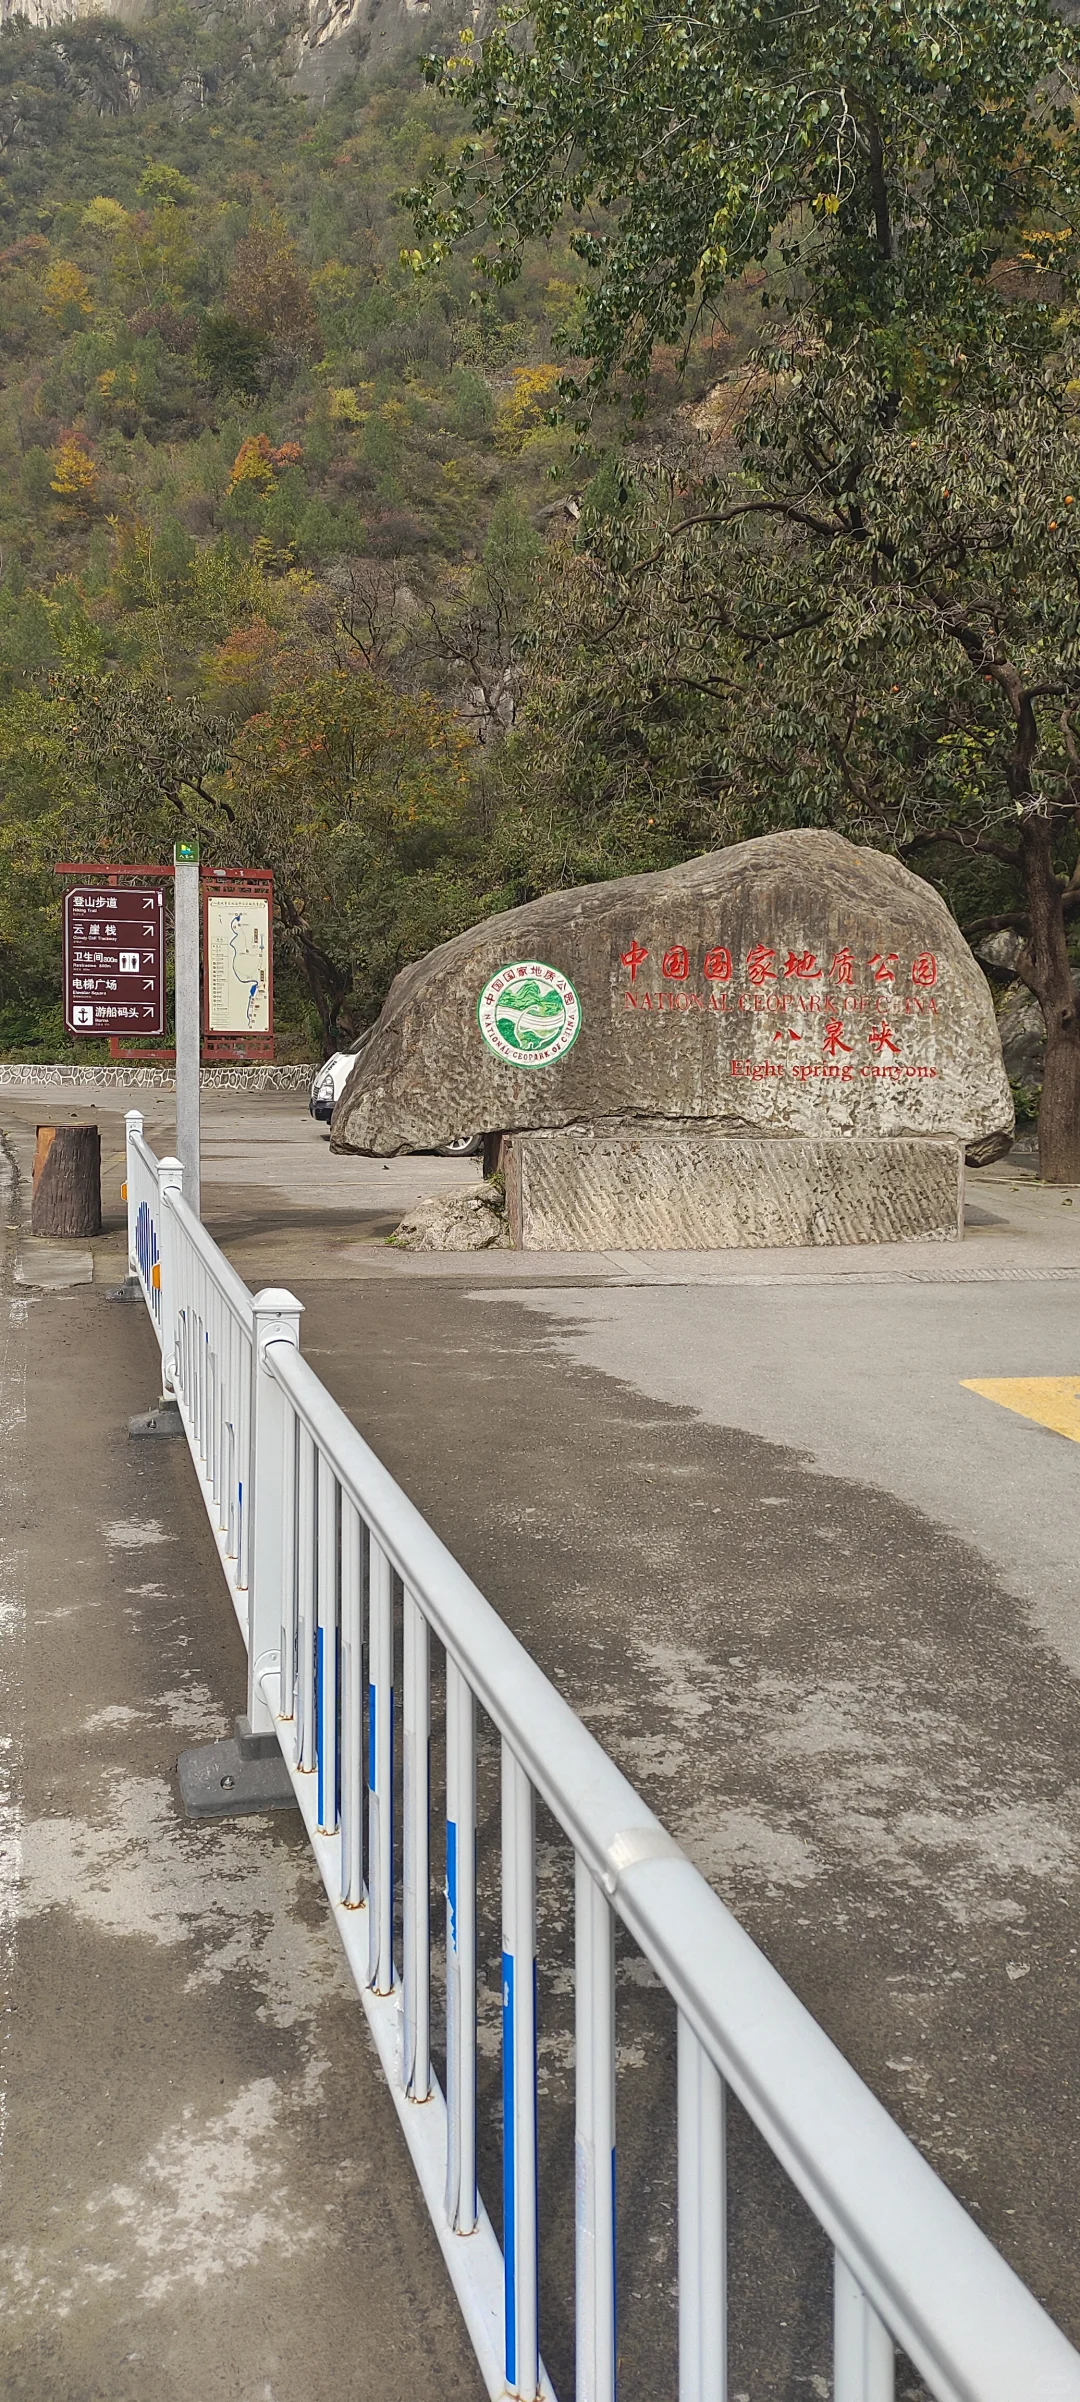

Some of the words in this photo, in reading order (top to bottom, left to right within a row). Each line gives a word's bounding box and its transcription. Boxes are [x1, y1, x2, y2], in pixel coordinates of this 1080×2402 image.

[73, 896, 118, 908] 登山步道
[620, 940, 937, 986] 中国国家地质公园
[72, 978, 118, 991] 电梯广场
[484, 966, 575, 1005] 中国国家地质公园
[95, 1006, 139, 1018] 游船码头
[624, 991, 733, 1012] NATIONAL
[843, 995, 869, 1014] OF
[484, 1014, 510, 1055] NATIONAL
[551, 1042, 562, 1053] OF
[773, 1017, 902, 1056] 八泉峡
[730, 1059, 784, 1081] Eight
[792, 1060, 853, 1082] spring
[860, 1065, 937, 1081] canyons
